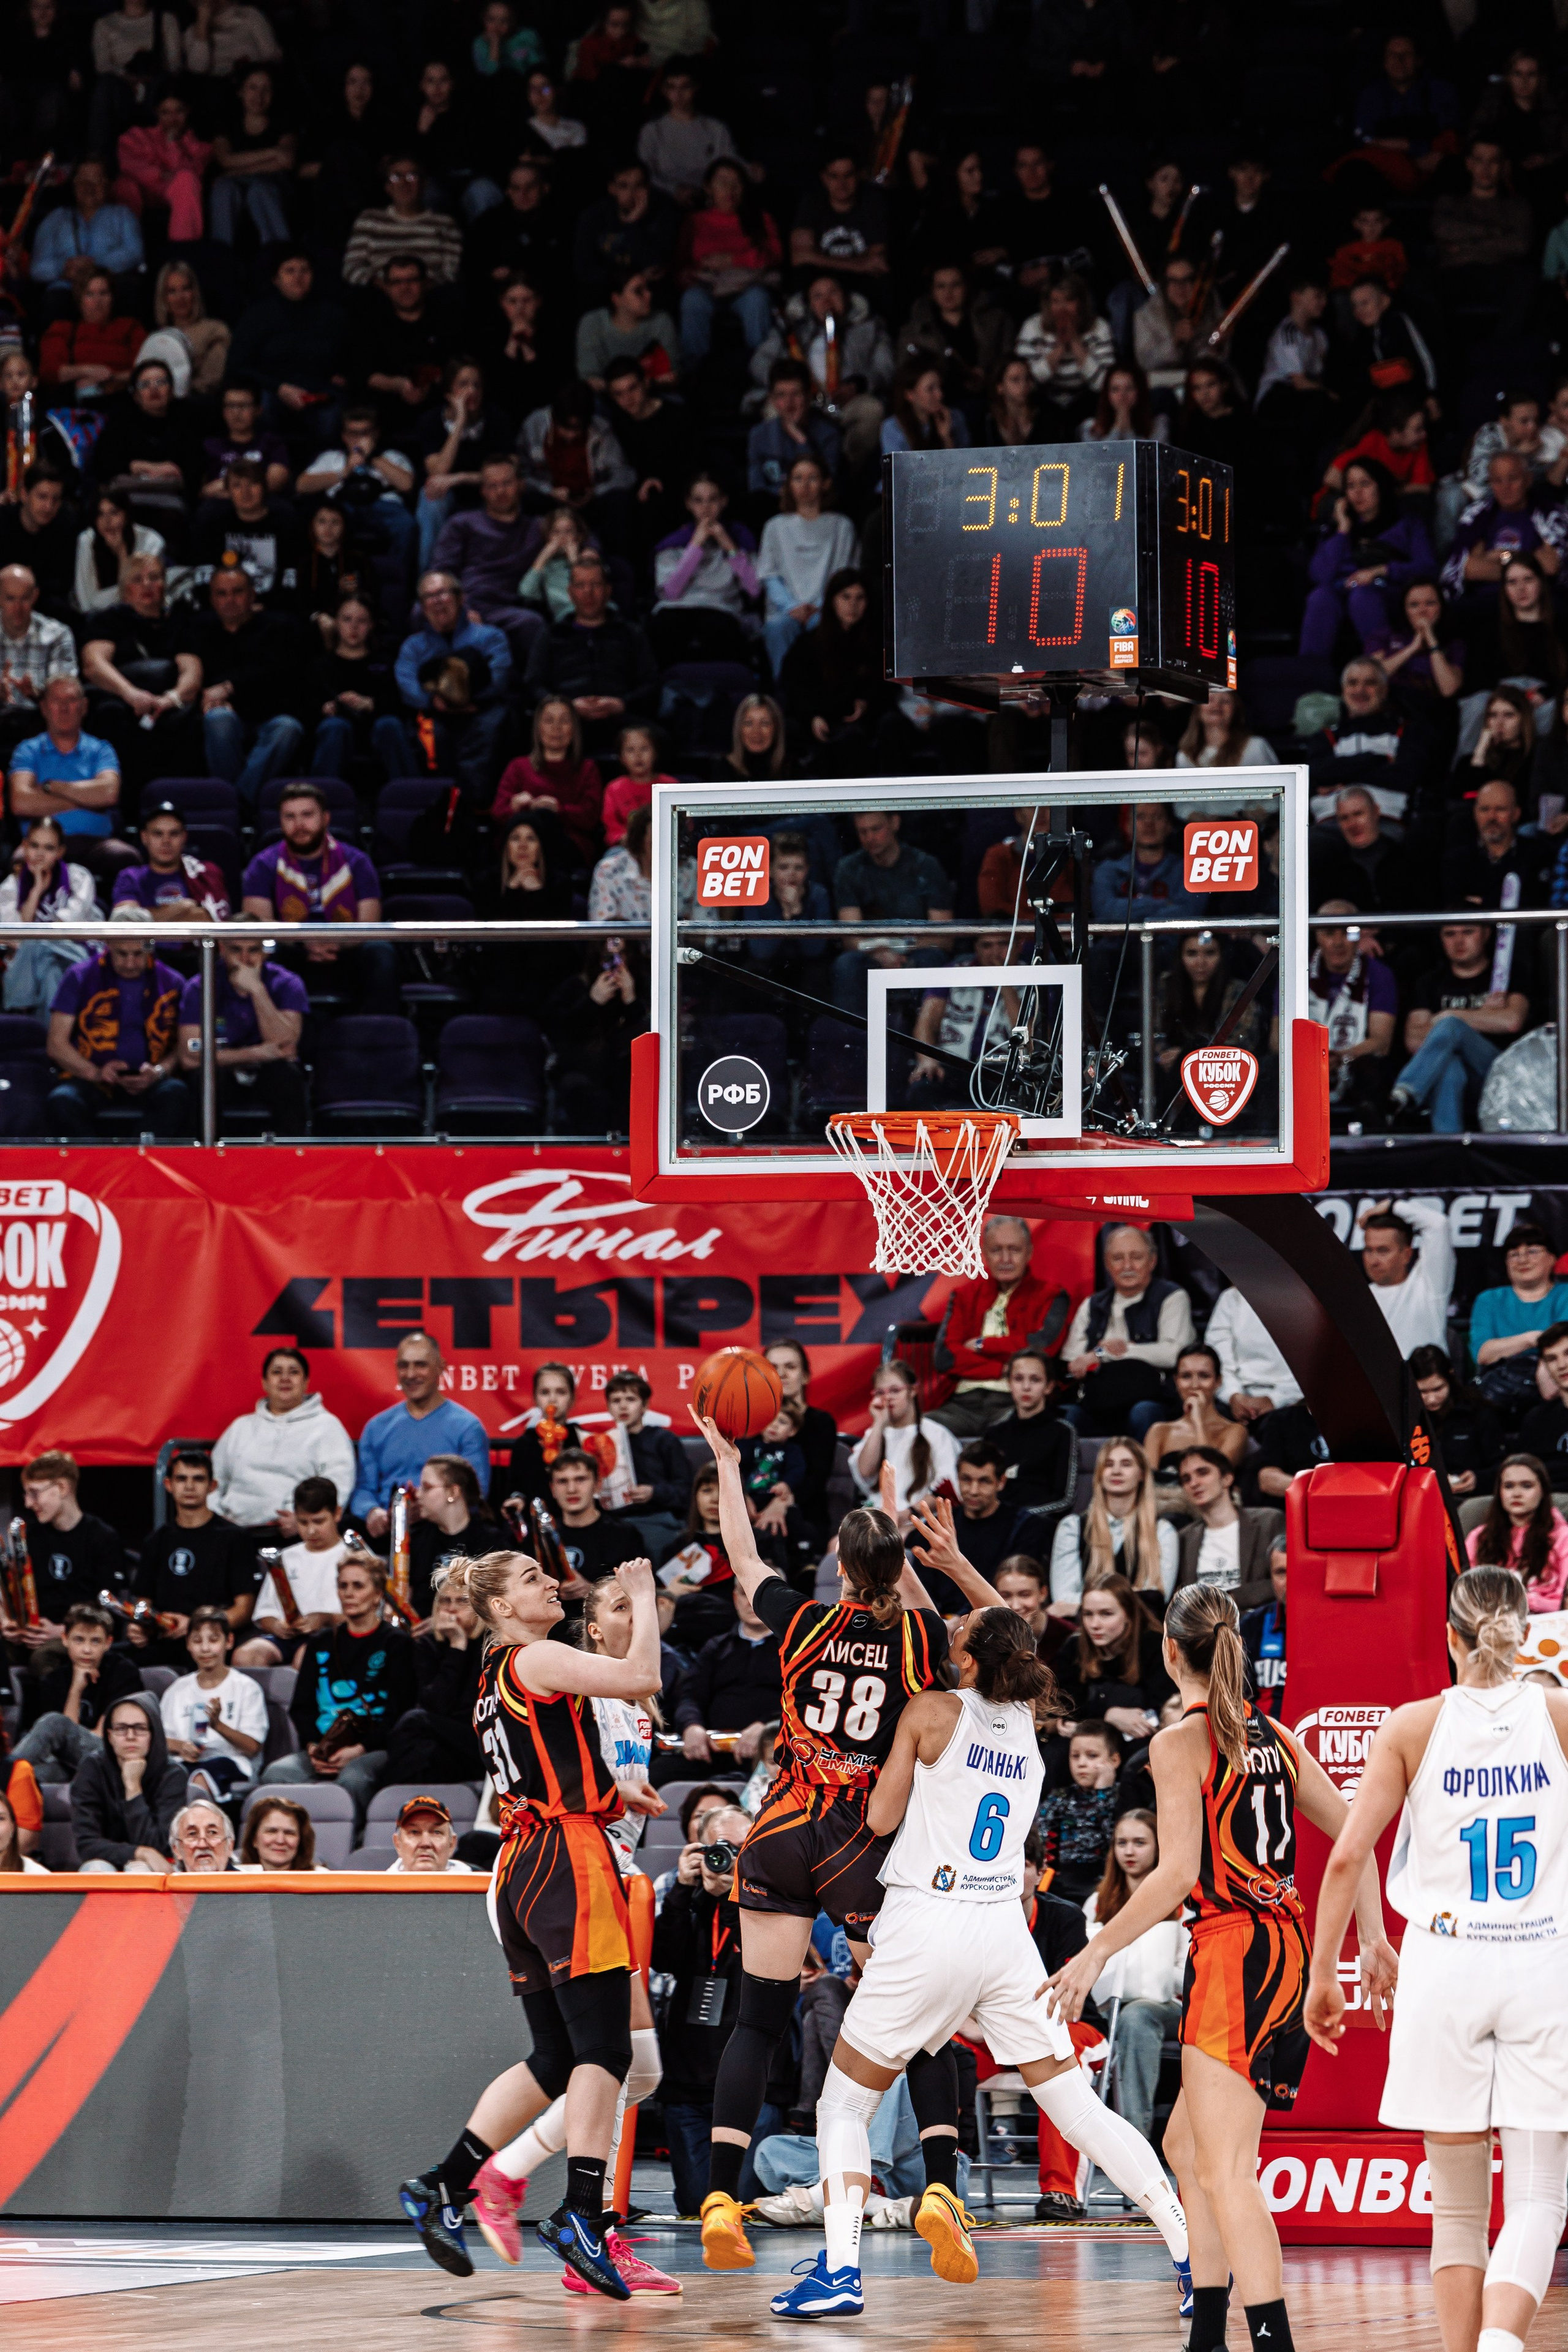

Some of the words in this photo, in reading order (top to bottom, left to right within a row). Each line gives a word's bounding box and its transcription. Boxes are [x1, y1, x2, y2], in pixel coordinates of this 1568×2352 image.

[962, 463, 1125, 532] 3:01
[1177, 469, 1229, 543] 3:01
[987, 547, 1087, 647] 10
[1186, 558, 1219, 660] 10
[1114, 641, 1134, 652] FIBA
[703, 845, 764, 870] FON
[1189, 829, 1253, 855] FON
[703, 871, 764, 897] BET
[1189, 856, 1253, 883] BET
[1199, 1062, 1242, 1082] КУБОК
[708, 1084, 761, 1104] РФБ
[0, 1186, 54, 1208] BET
[462, 1168, 723, 1262] Финал
[821, 1640, 888, 1670] ЛИСЕЦ
[804, 1670, 886, 1741] 38
[1324, 1711, 1385, 1722] FONBET
[483, 1717, 522, 1795] 31
[967, 1743, 1028, 1780] ШТАНЬК
[1319, 1730, 1376, 1763] КУБО
[968, 1792, 1010, 1862] 6
[1251, 1779, 1291, 1866] 11
[1460, 1815, 1537, 1902] 15
[1256, 2155, 1502, 2214] ONBE
